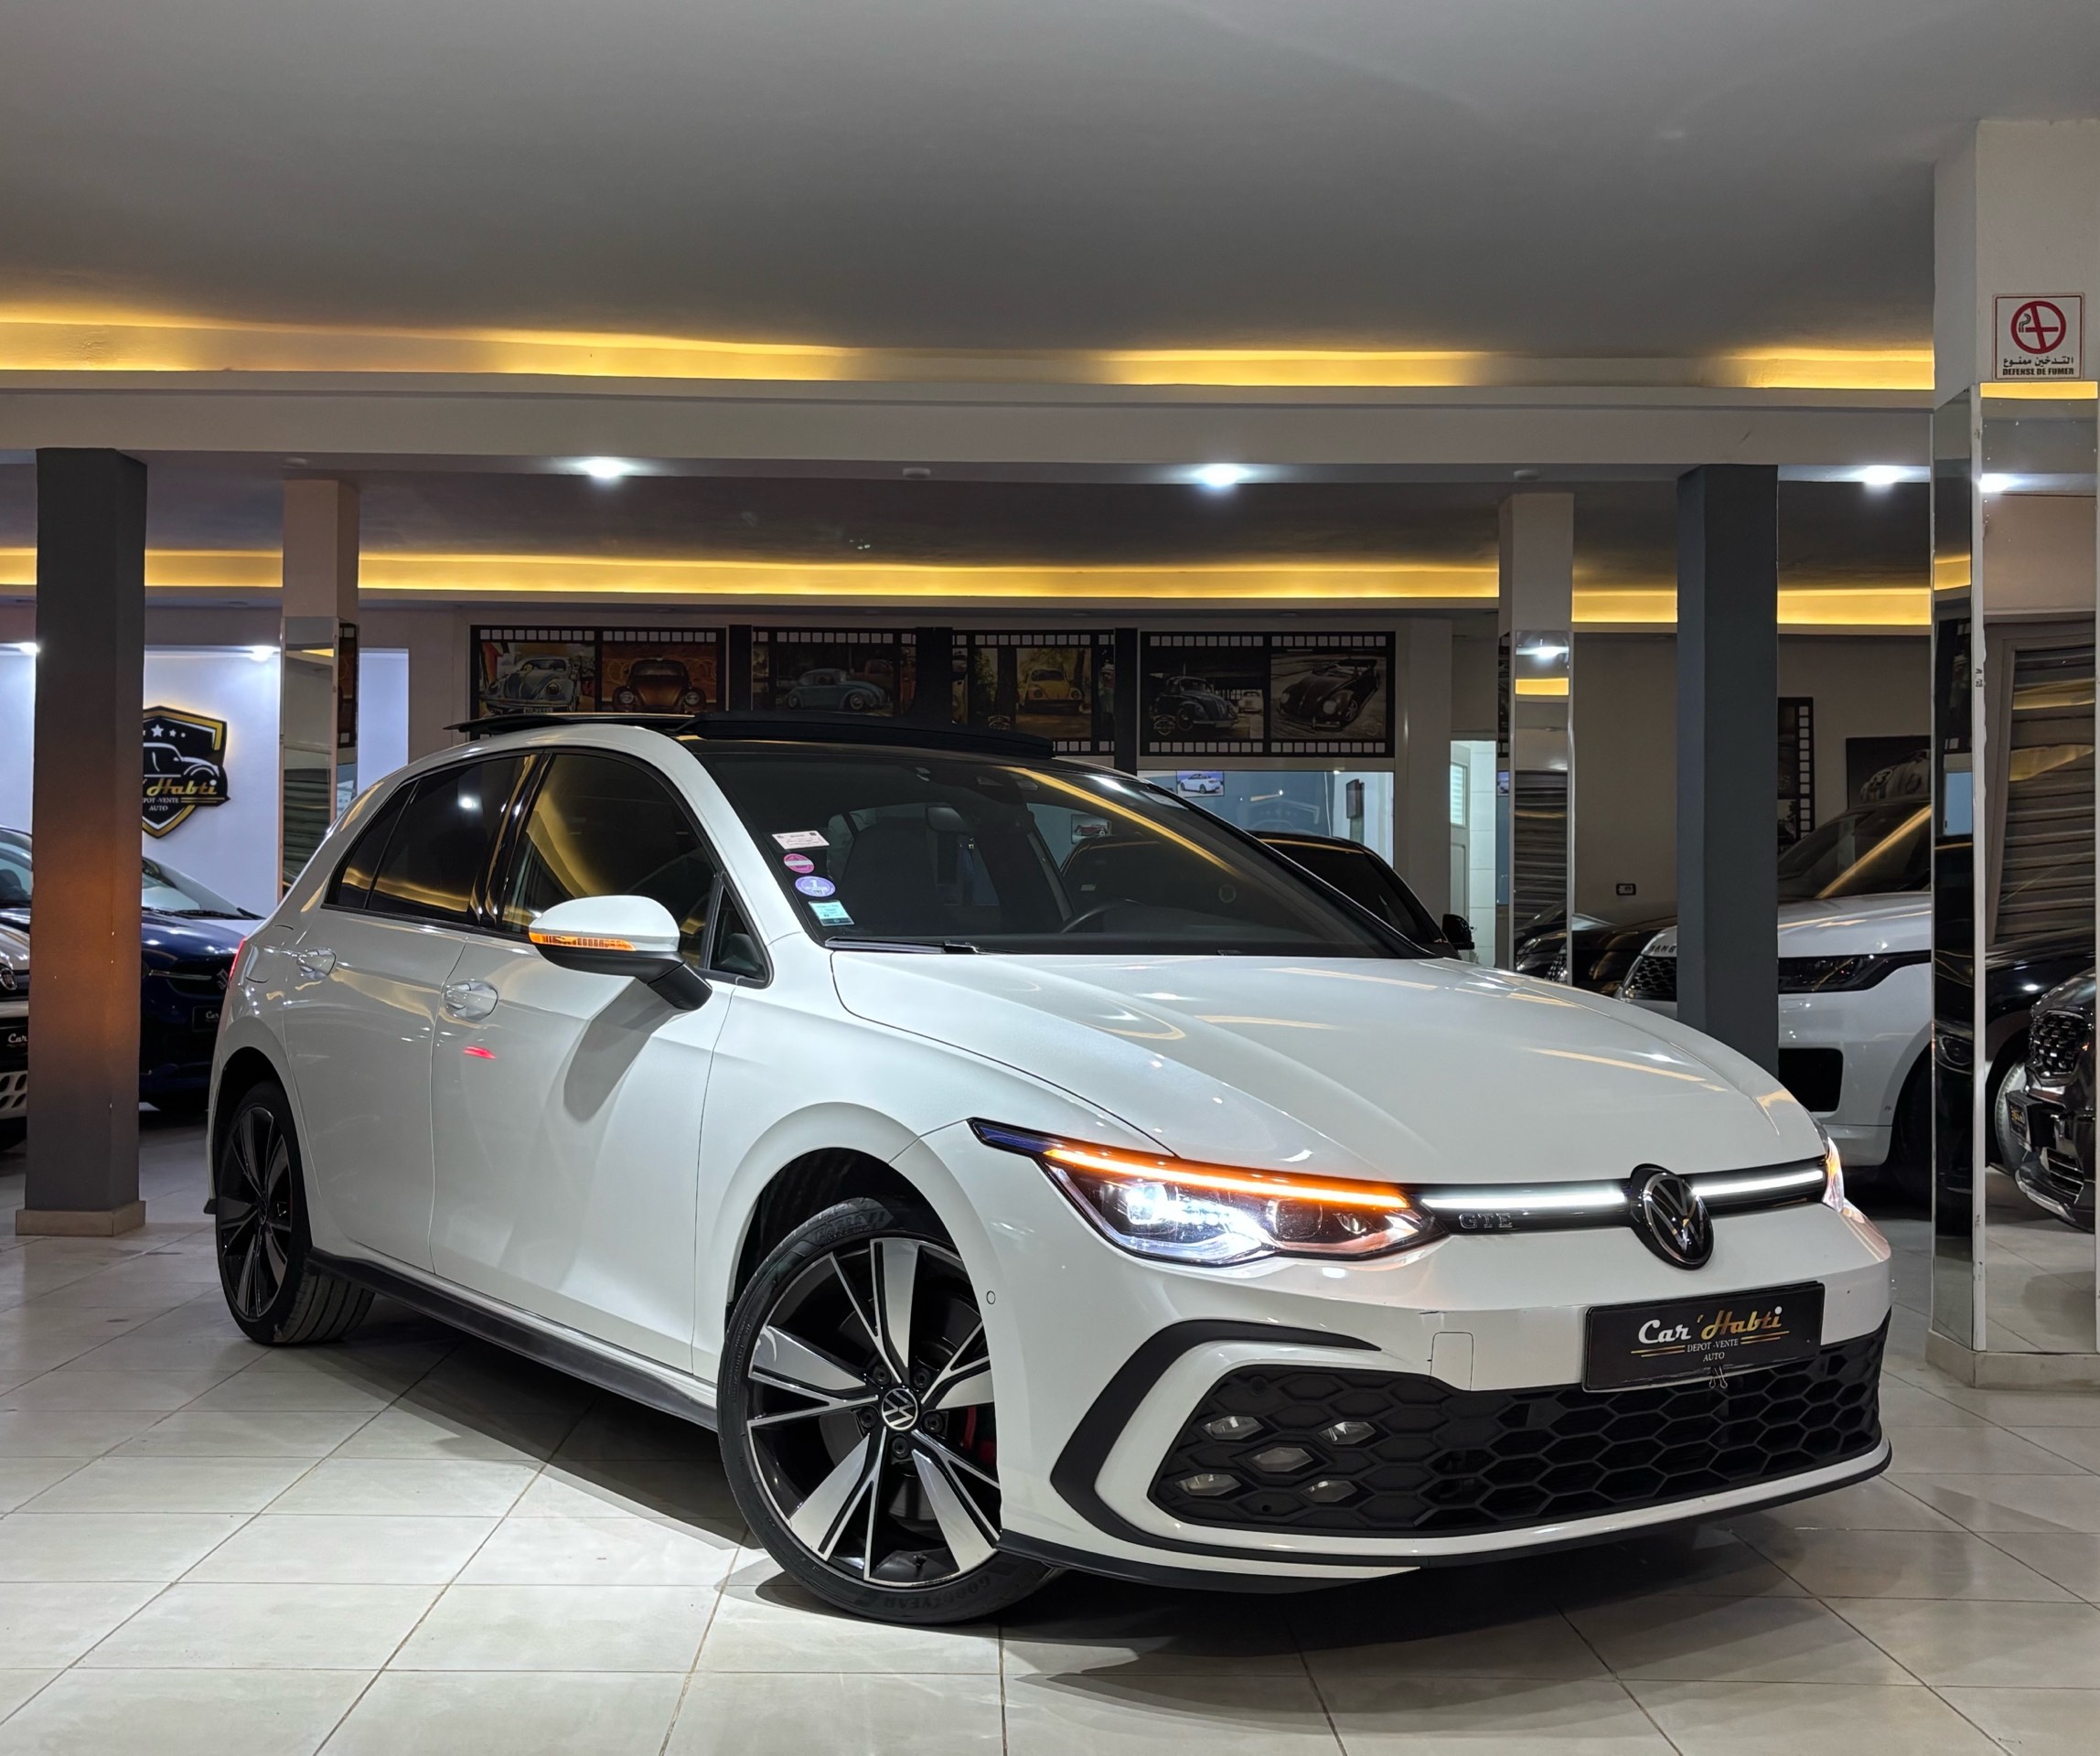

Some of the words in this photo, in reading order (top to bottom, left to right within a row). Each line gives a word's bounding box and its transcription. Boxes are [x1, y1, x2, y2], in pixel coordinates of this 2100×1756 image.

[2003, 368, 2035, 376] DEFENSE
[7, 1033, 27, 1043] Car
[1459, 1212, 1513, 1230] GTE
[1637, 1319, 1691, 1344] Car
[1687, 1342, 1711, 1353] DEPOT
[1702, 1352, 1725, 1363] AUTO
